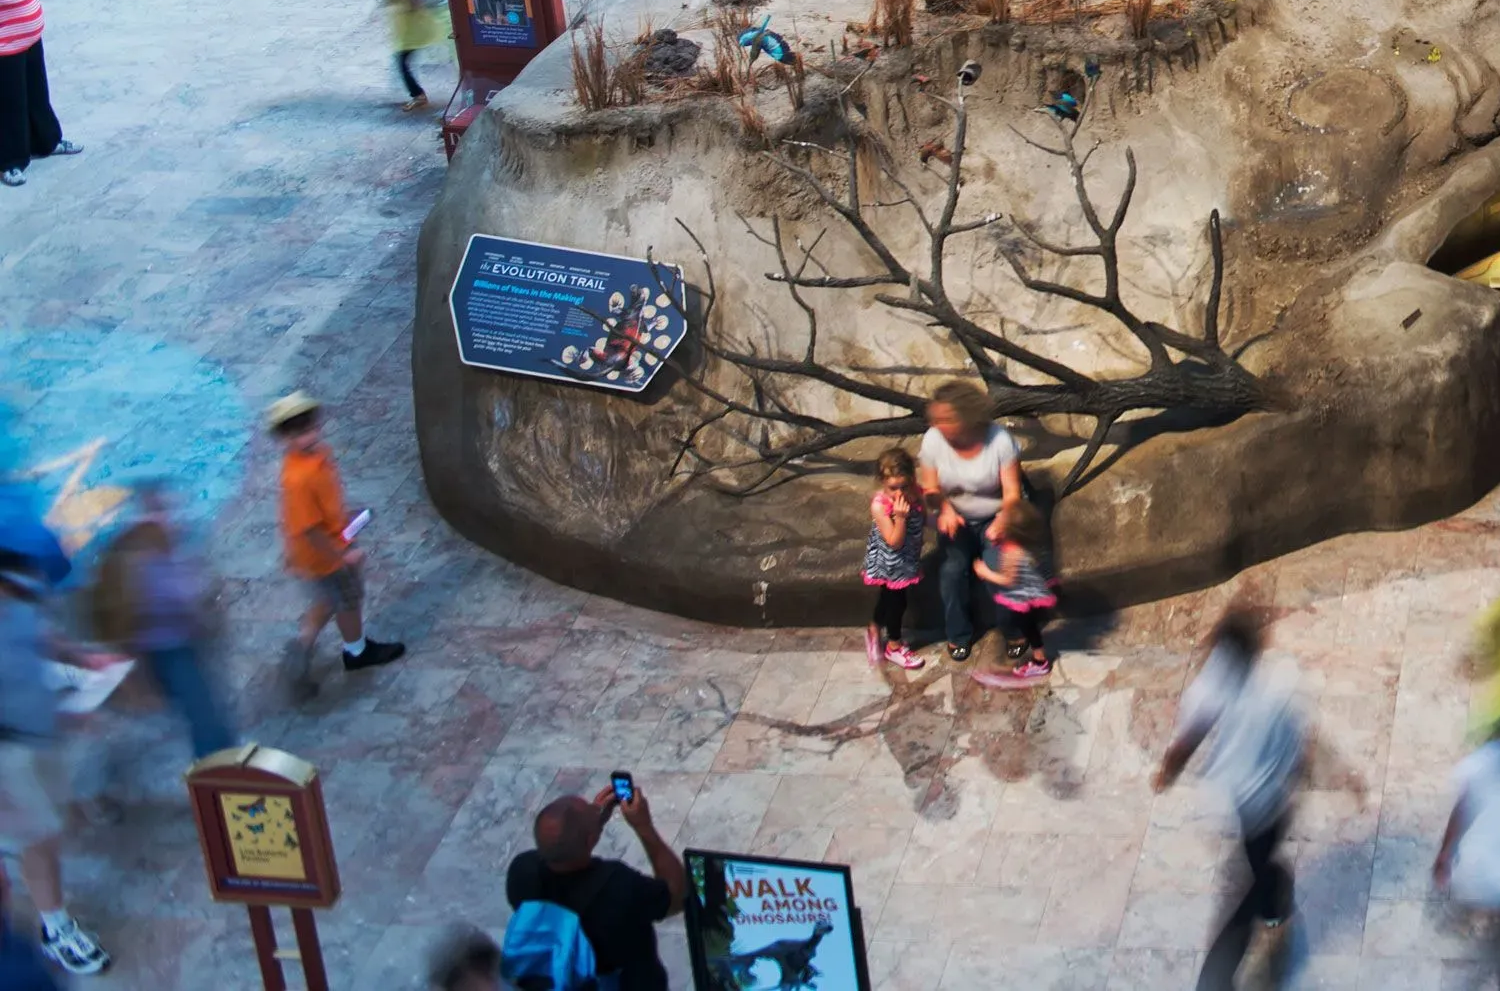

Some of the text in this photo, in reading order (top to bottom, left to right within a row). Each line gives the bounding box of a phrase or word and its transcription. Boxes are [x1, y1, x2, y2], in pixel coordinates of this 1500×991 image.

[480, 261, 491, 272] the
[492, 264, 567, 284] EVOLUTION
[570, 275, 606, 290] TRAIL
[473, 279, 500, 290] Billions
[511, 285, 529, 295] Years
[530, 288, 538, 296] in
[539, 289, 551, 299] the
[552, 291, 584, 306] Making!
[724, 876, 816, 900] WALK
[761, 897, 838, 912] AMONG
[735, 913, 832, 925] DINOSAURS!
